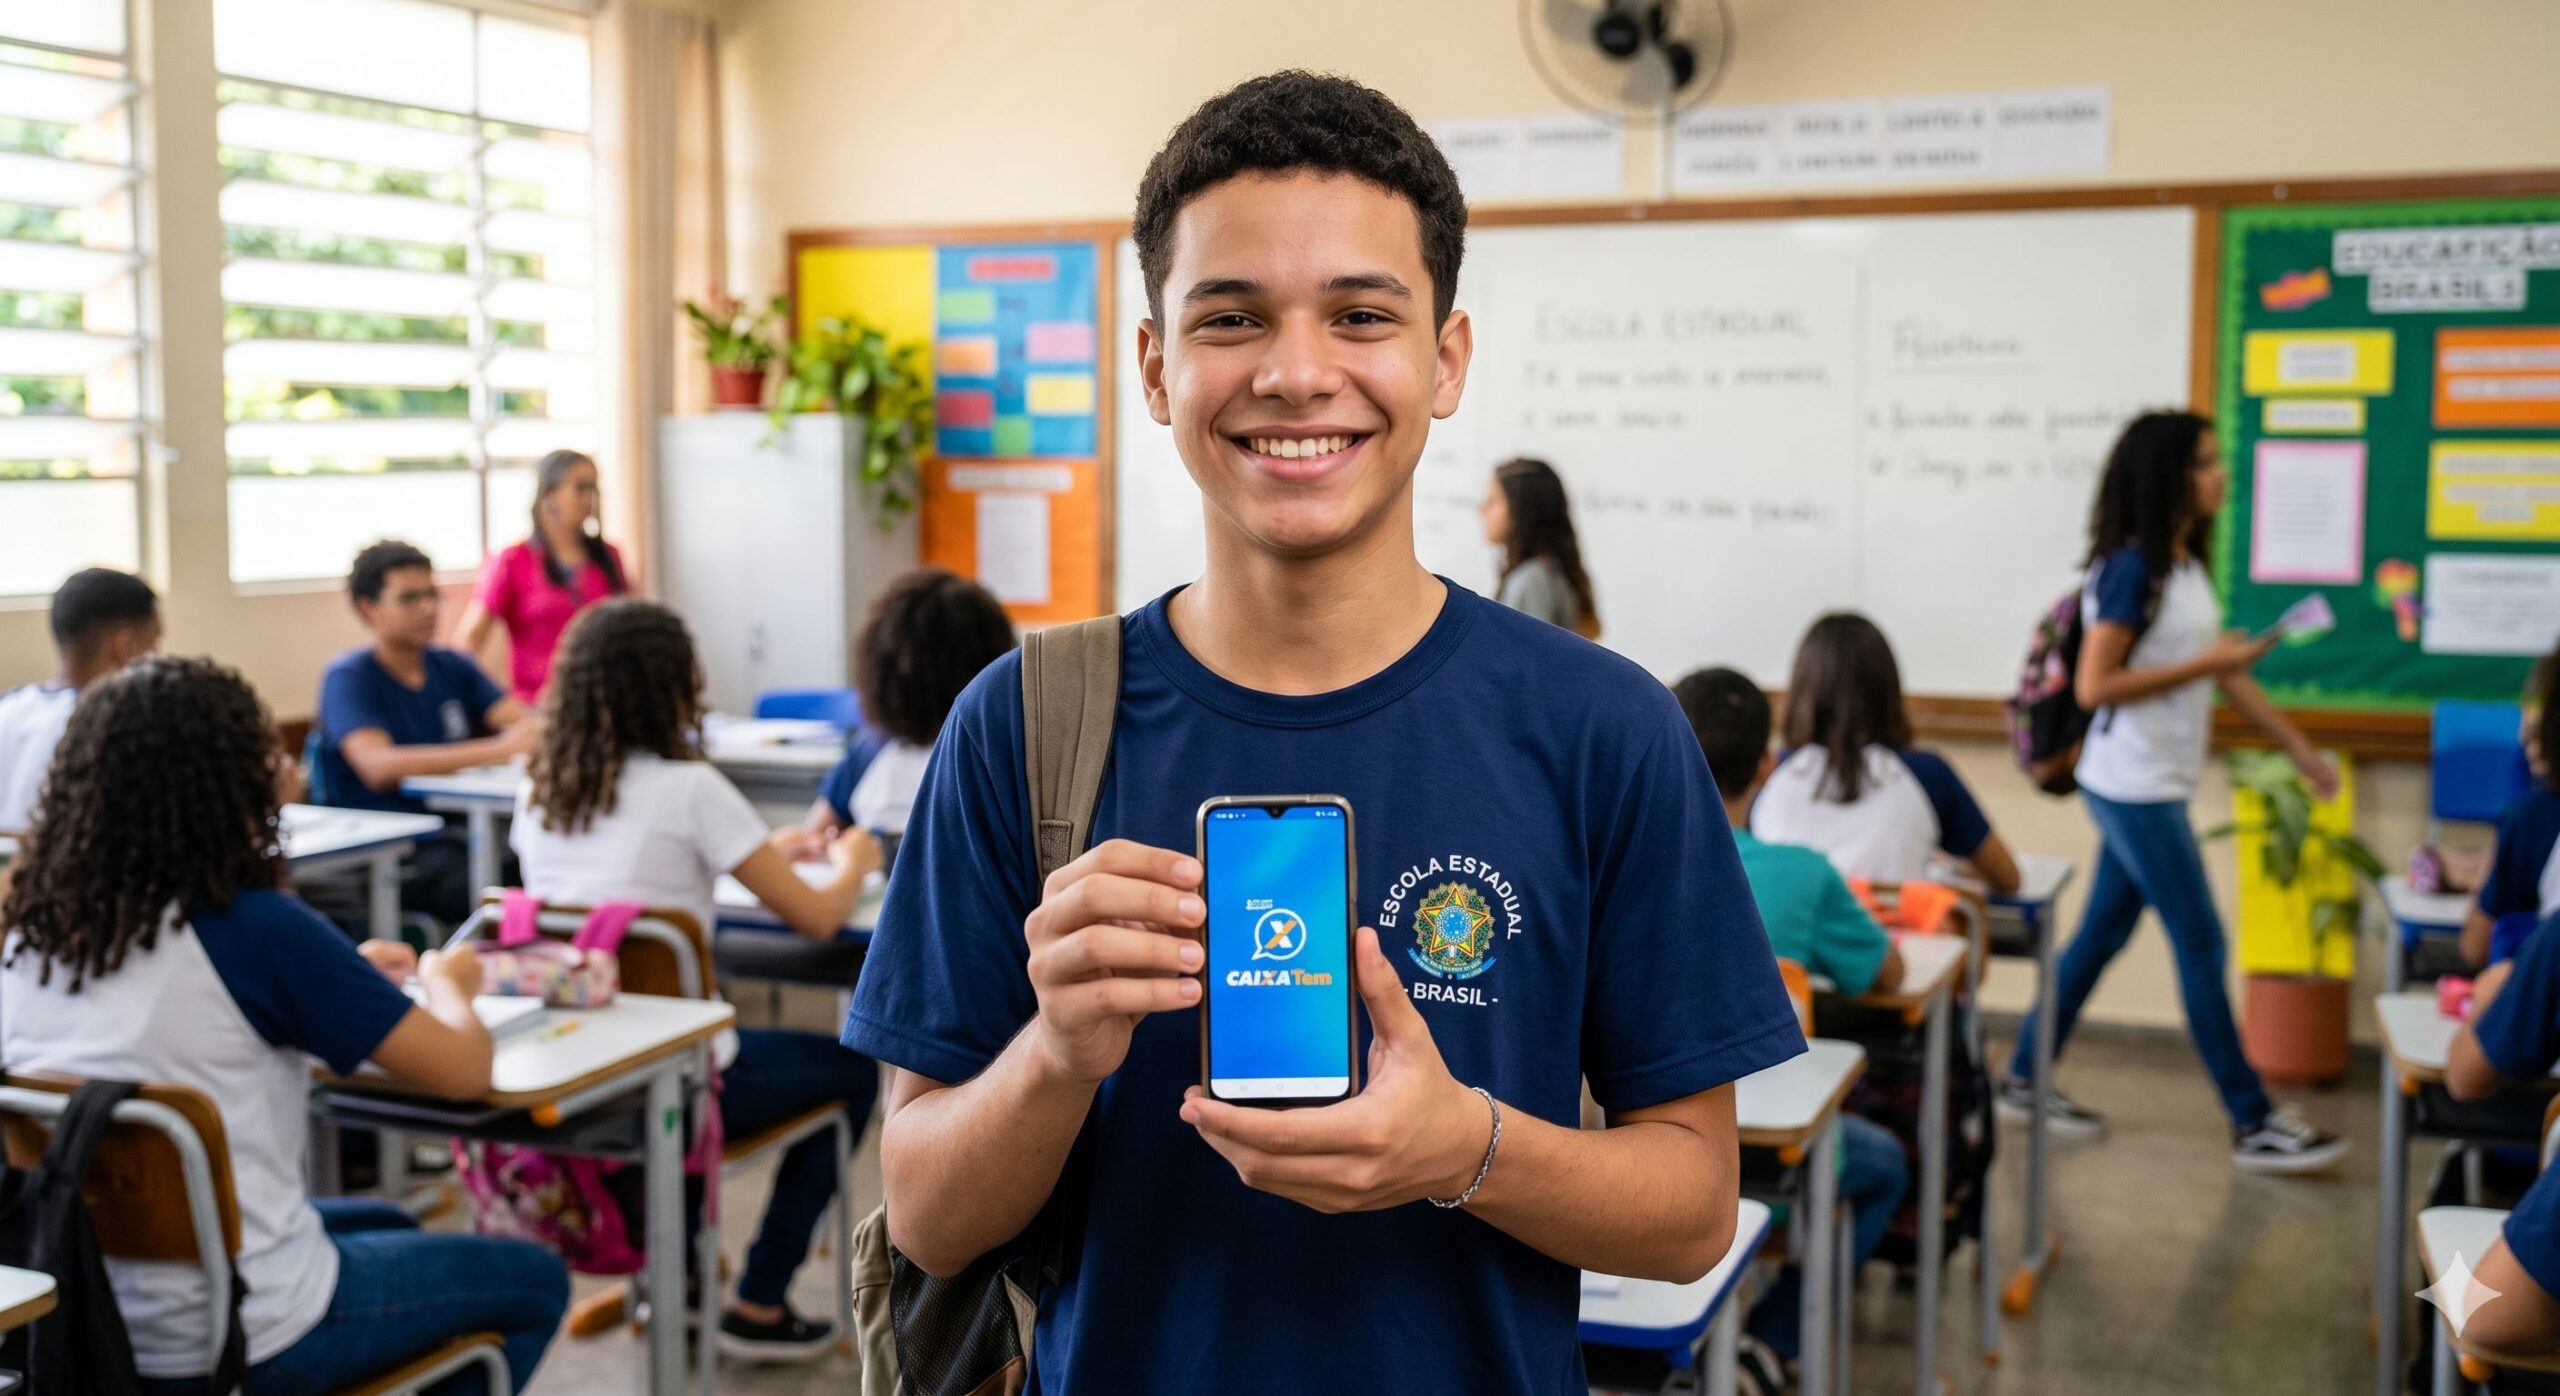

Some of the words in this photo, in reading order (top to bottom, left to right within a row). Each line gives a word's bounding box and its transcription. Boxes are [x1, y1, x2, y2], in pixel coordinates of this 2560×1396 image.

[1379, 857, 1444, 928] ESCOLA
[1449, 854, 1522, 940] ESTADUAL
[1226, 969, 1291, 986] CAIXA
[1291, 969, 1332, 985] Tem
[1413, 982, 1487, 1006] BRASIL
